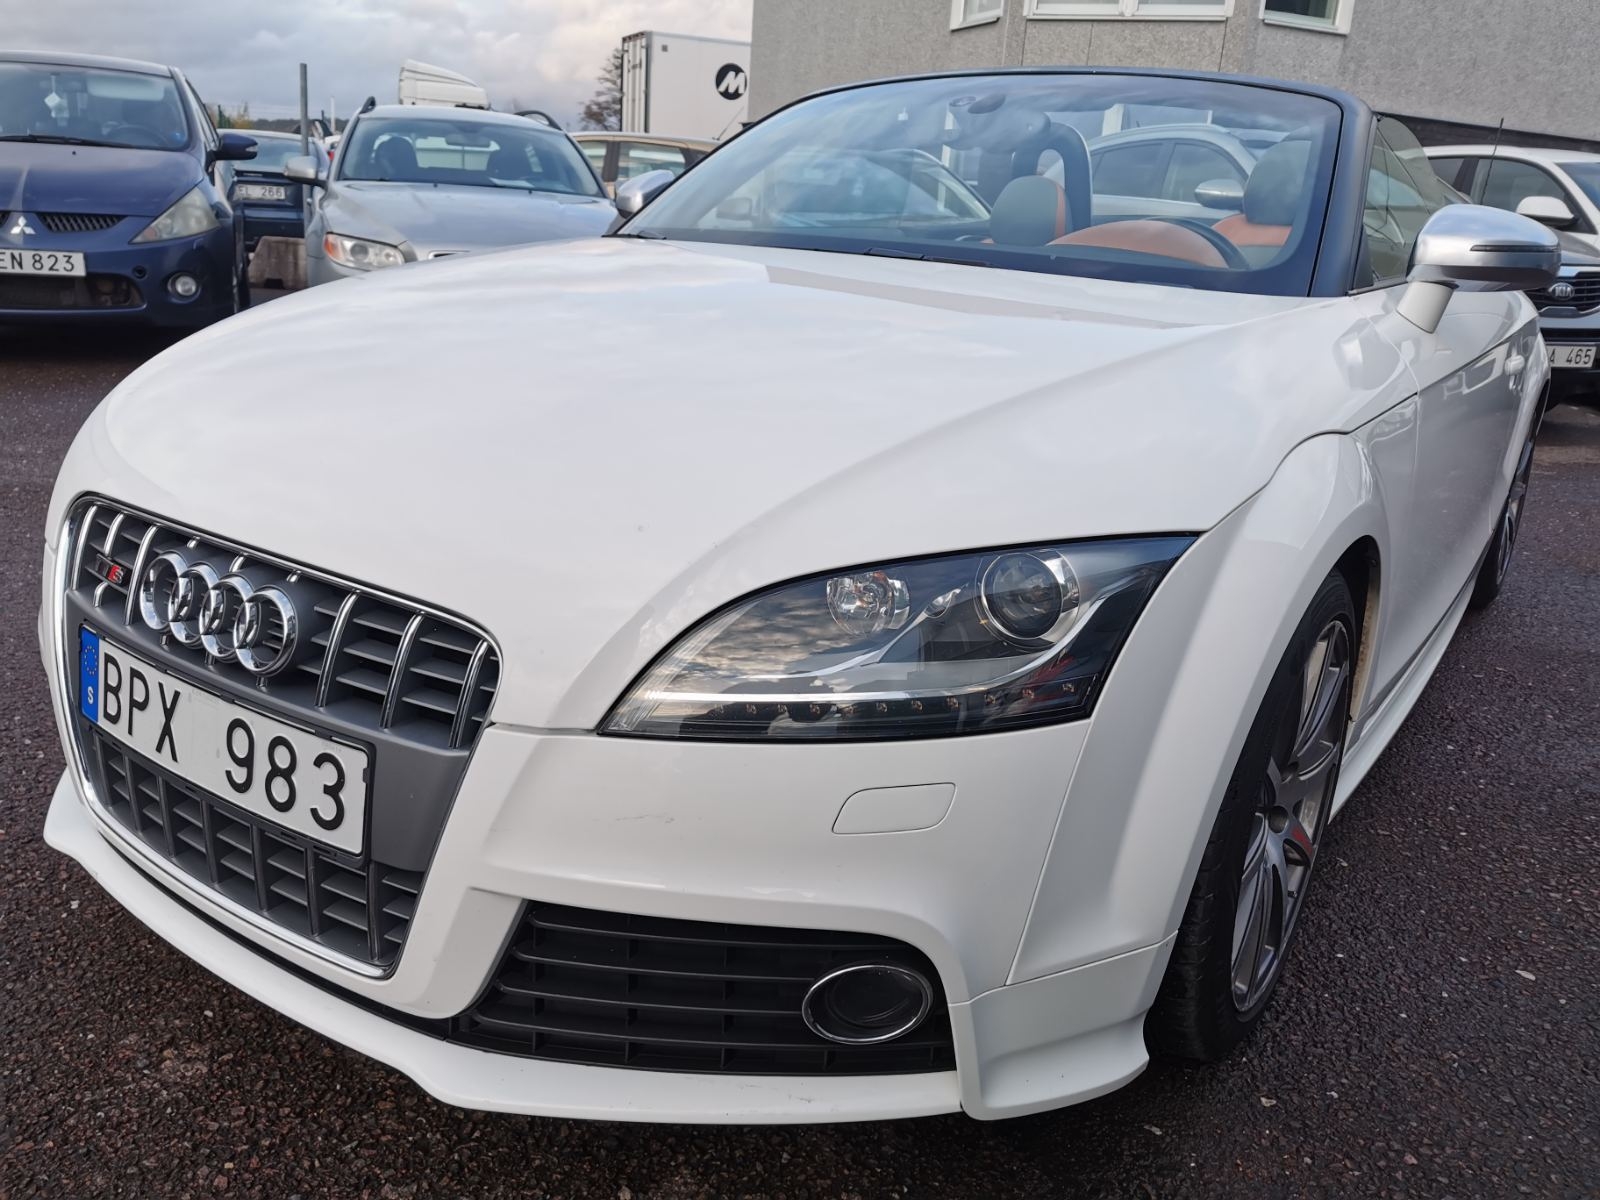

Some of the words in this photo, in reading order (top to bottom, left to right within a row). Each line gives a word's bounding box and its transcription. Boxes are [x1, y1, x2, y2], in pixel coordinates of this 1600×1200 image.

[717, 70, 745, 94] M
[32, 253, 75, 272] 823
[1555, 285, 1573, 297] KIA
[1566, 348, 1592, 365] 465
[87, 685, 95, 704] S
[103, 651, 181, 763] BPX
[224, 717, 346, 831] 983
